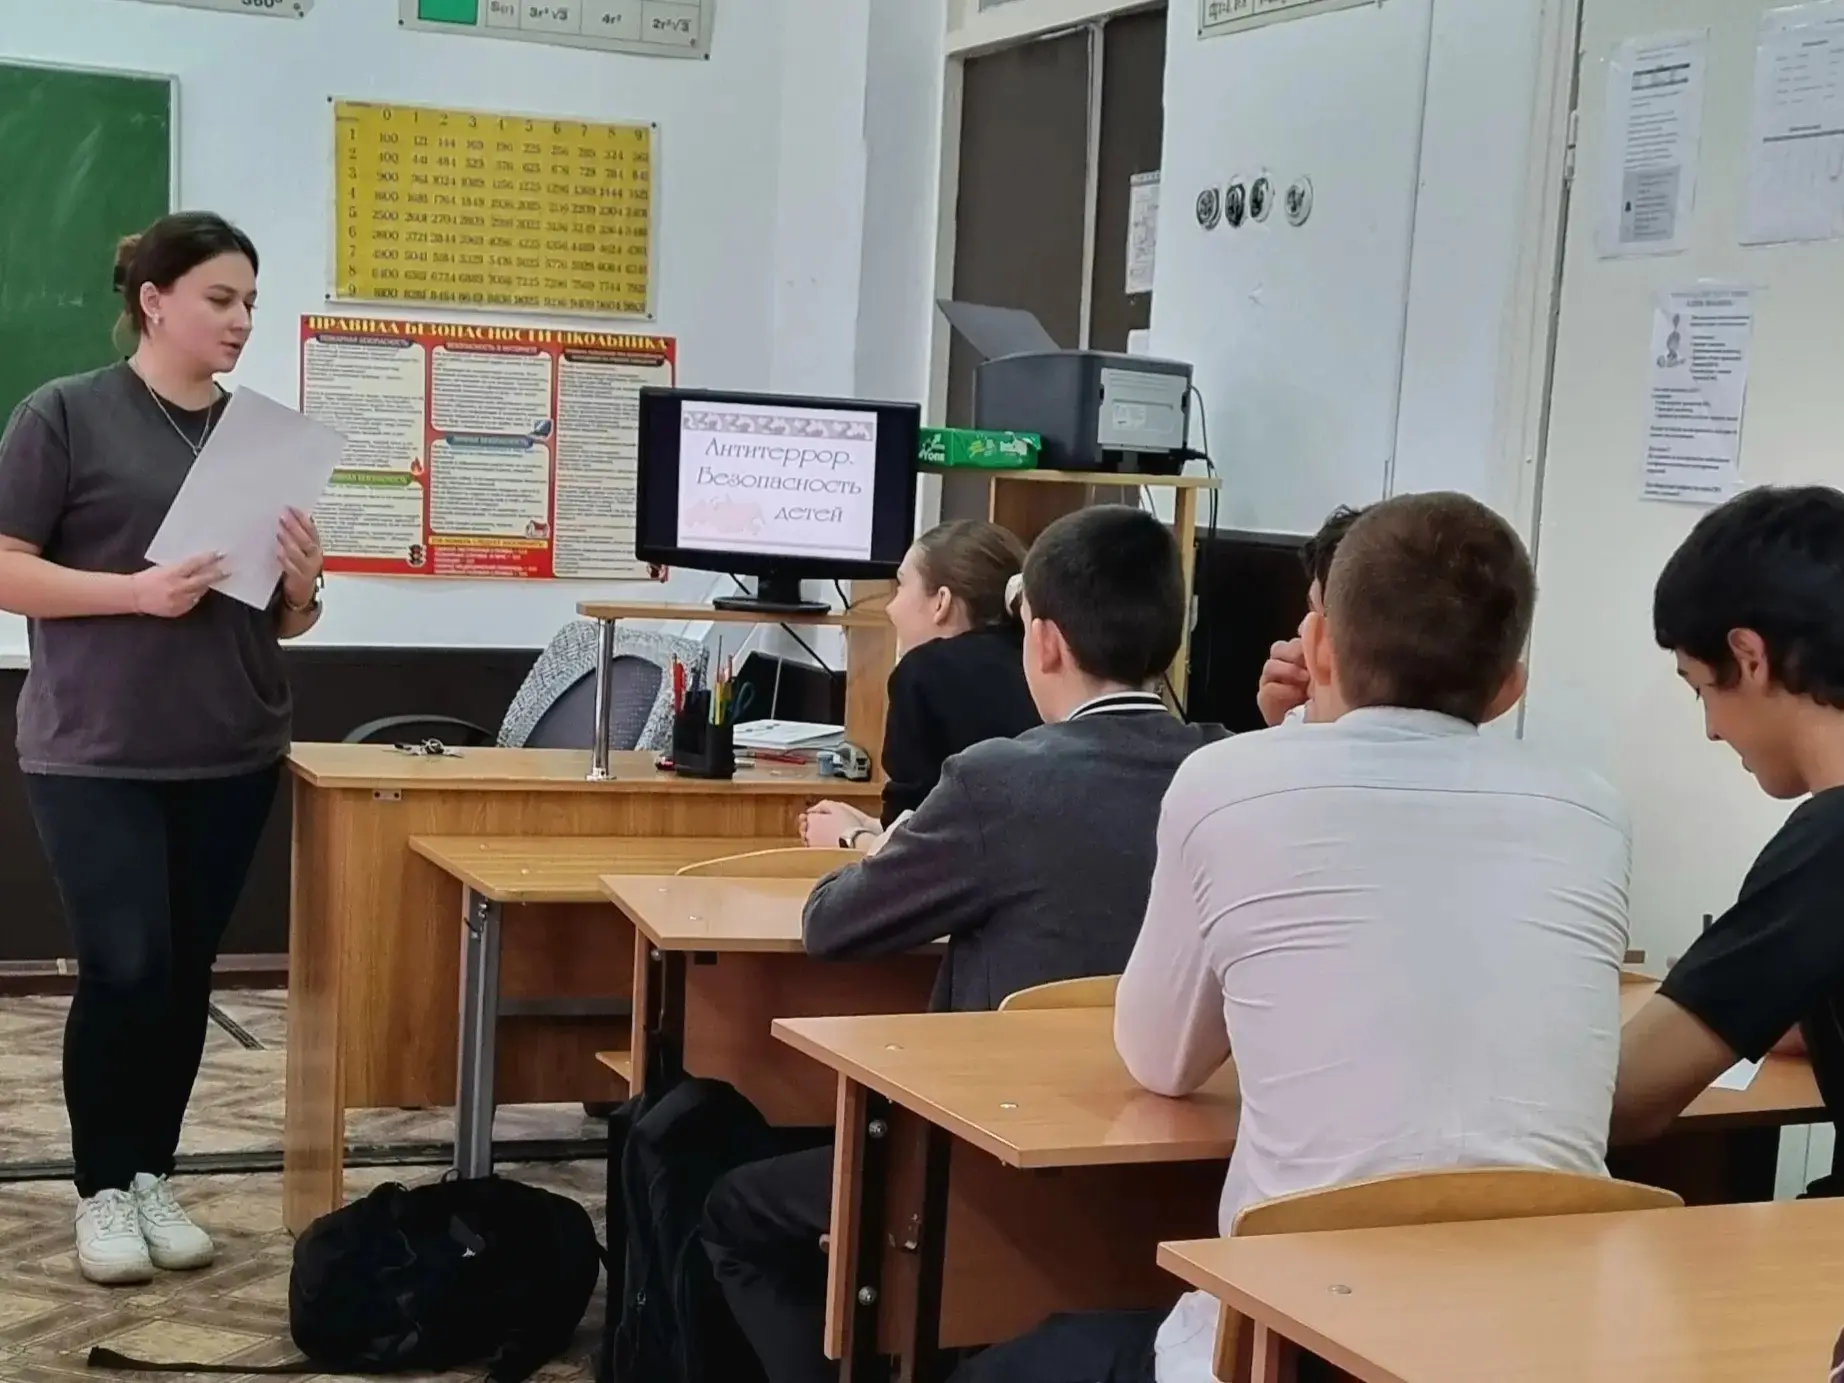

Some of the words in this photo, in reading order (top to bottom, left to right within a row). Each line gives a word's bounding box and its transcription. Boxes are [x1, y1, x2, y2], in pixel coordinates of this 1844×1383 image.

[382, 108, 391, 120] 0
[413, 111, 417, 123] 1
[439, 113, 448, 125] 2
[468, 115, 476, 128] 3
[553, 121, 561, 134] 6
[580, 124, 587, 136] 7
[634, 129, 642, 140] 9
[350, 128, 355, 139] 1
[379, 131, 398, 143] 100
[349, 147, 356, 159] 2
[349, 166, 356, 178] 3
[348, 205, 357, 217] 5
[348, 225, 356, 237] 6
[349, 244, 356, 257] 7
[348, 264, 356, 276] 8
[348, 283, 356, 296] 9
[309, 316, 400, 335] ПРАВИЛА
[405, 322, 552, 343] БЕЗОПАСНОСТИ
[556, 331, 668, 350] ШКОЛЬНИКА
[704, 438, 854, 470] Антитеррор.
[697, 466, 862, 495] Безопасность
[774, 506, 843, 523] детей
